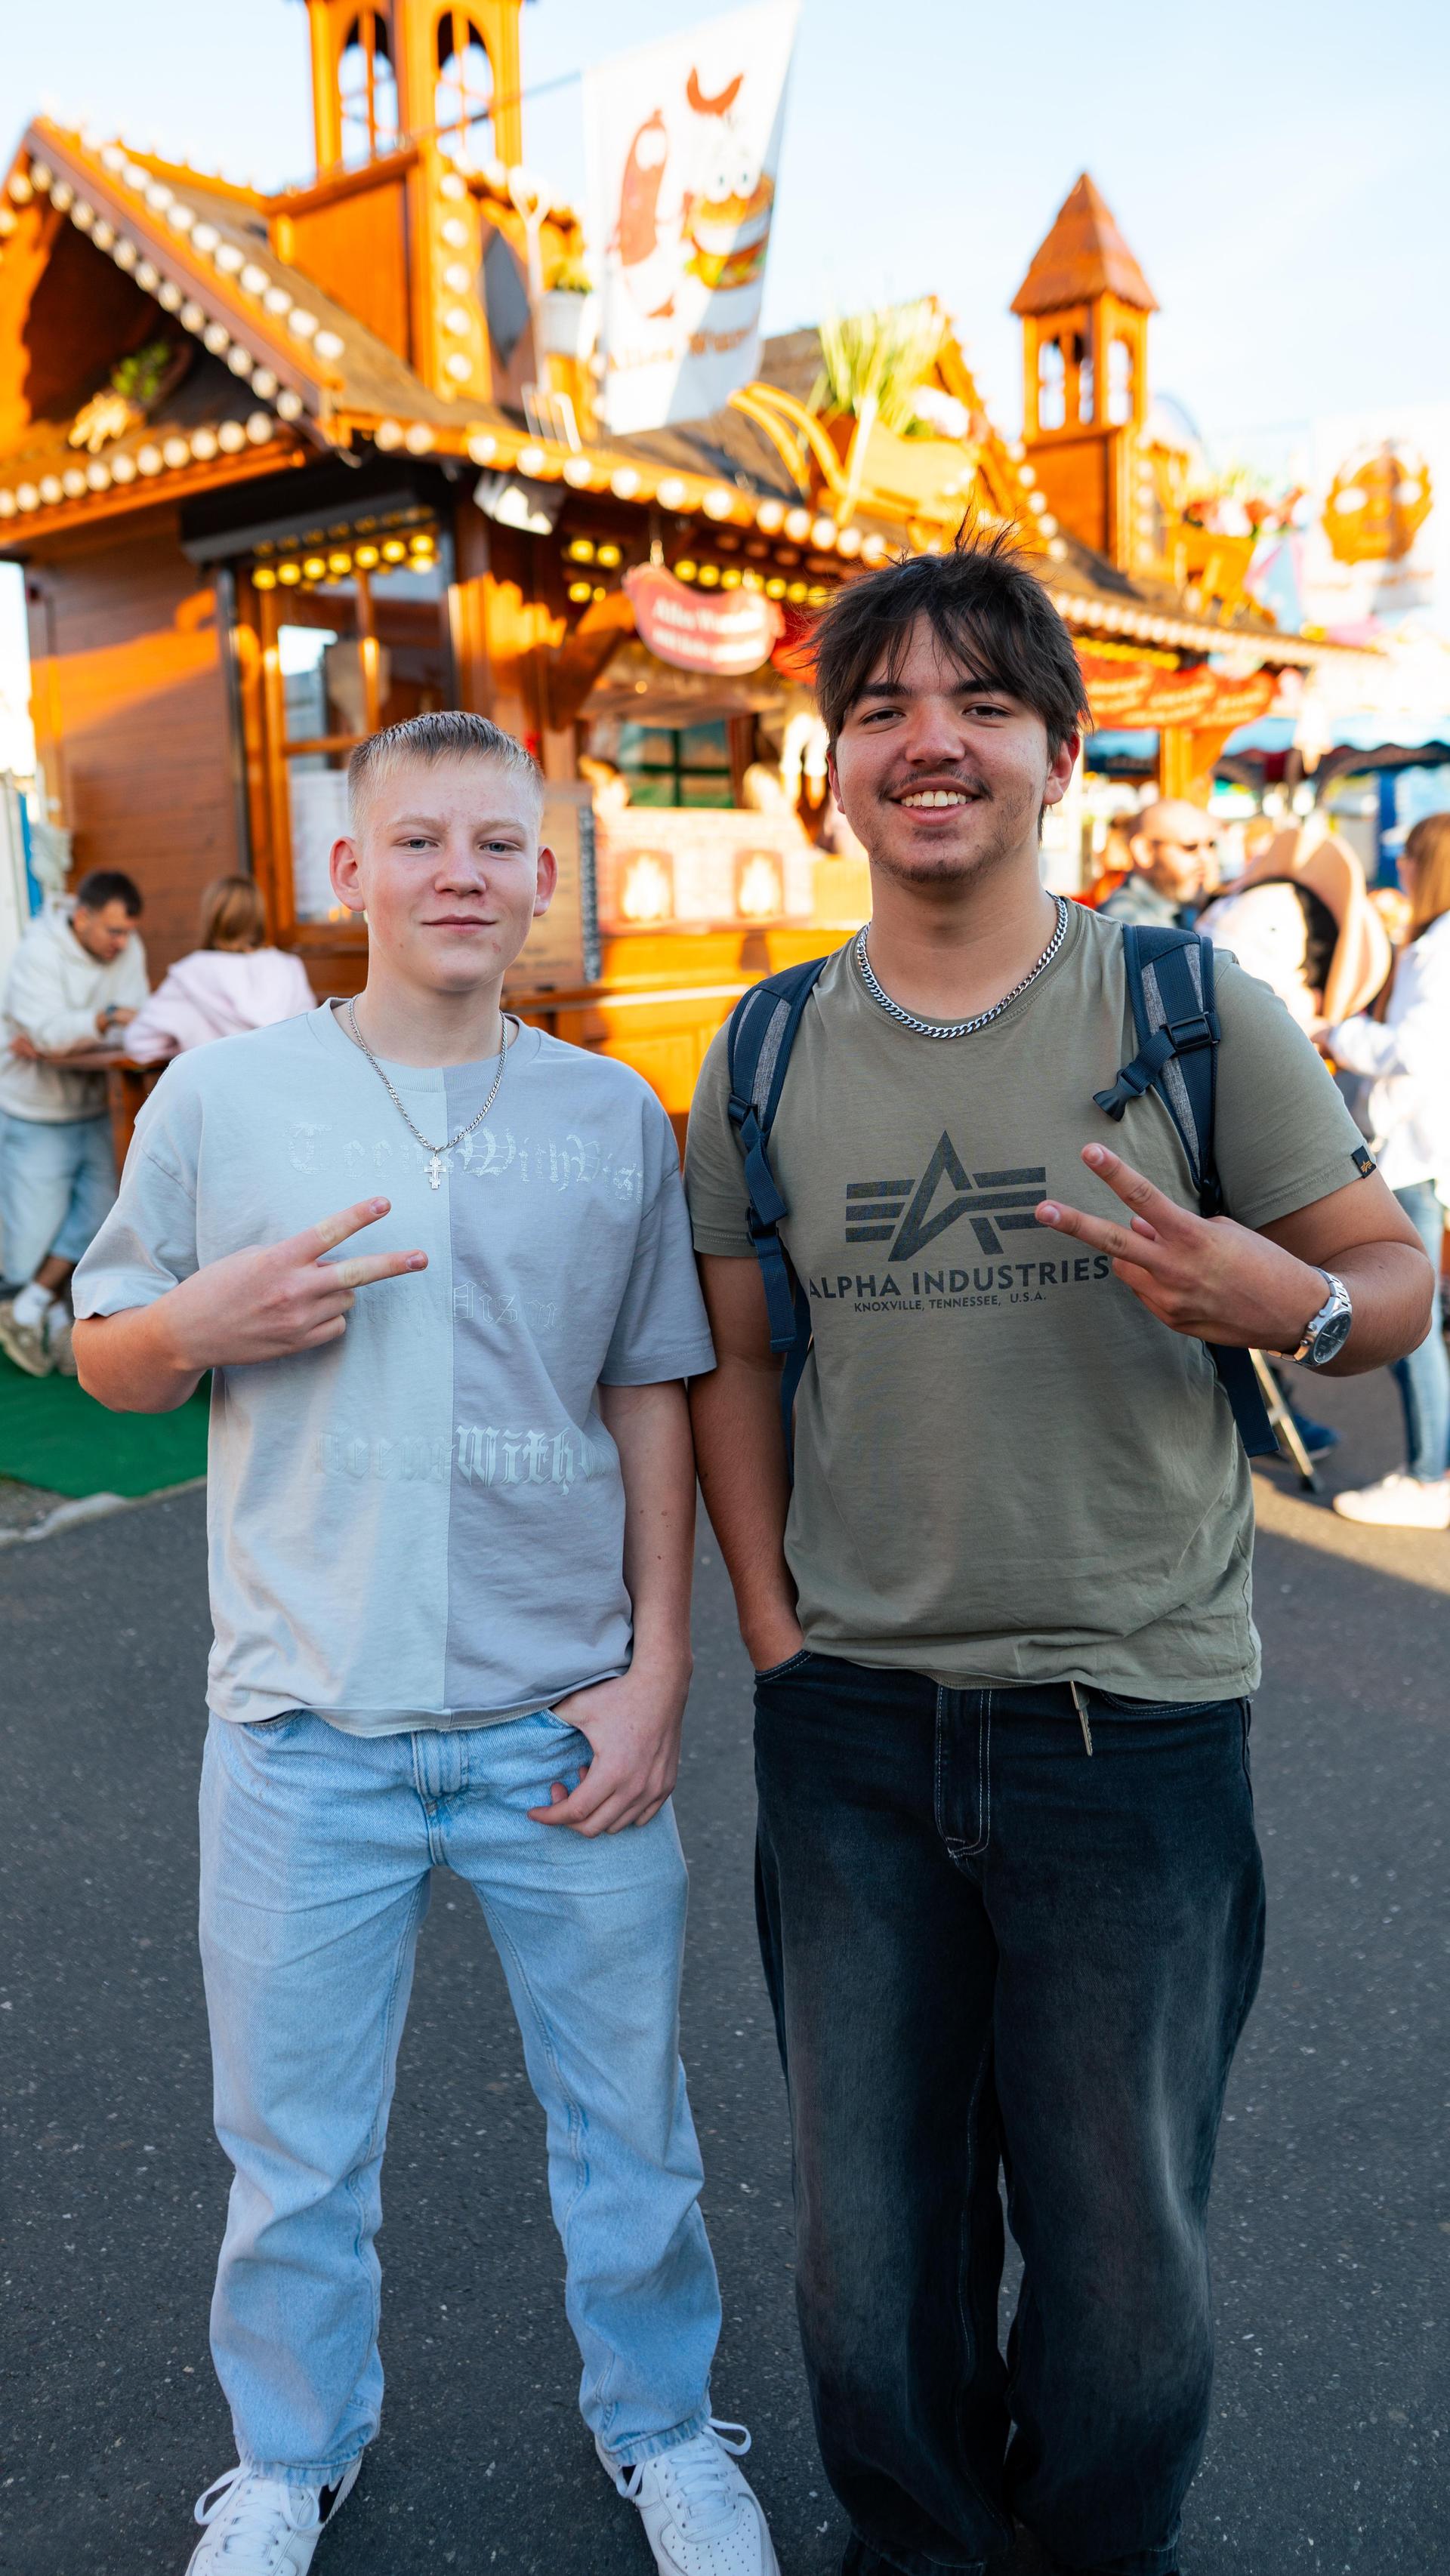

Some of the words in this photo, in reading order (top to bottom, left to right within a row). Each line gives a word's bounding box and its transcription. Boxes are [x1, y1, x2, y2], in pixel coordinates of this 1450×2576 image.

[809, 1273, 902, 1299] ALPHA
[912, 1255, 1109, 1296] INDUSTRIES
[854, 1299, 925, 1312] KNOXVILLE,
[929, 1295, 1001, 1310] TENNESSEE,
[1010, 1291, 1047, 1305] U.S.A.
